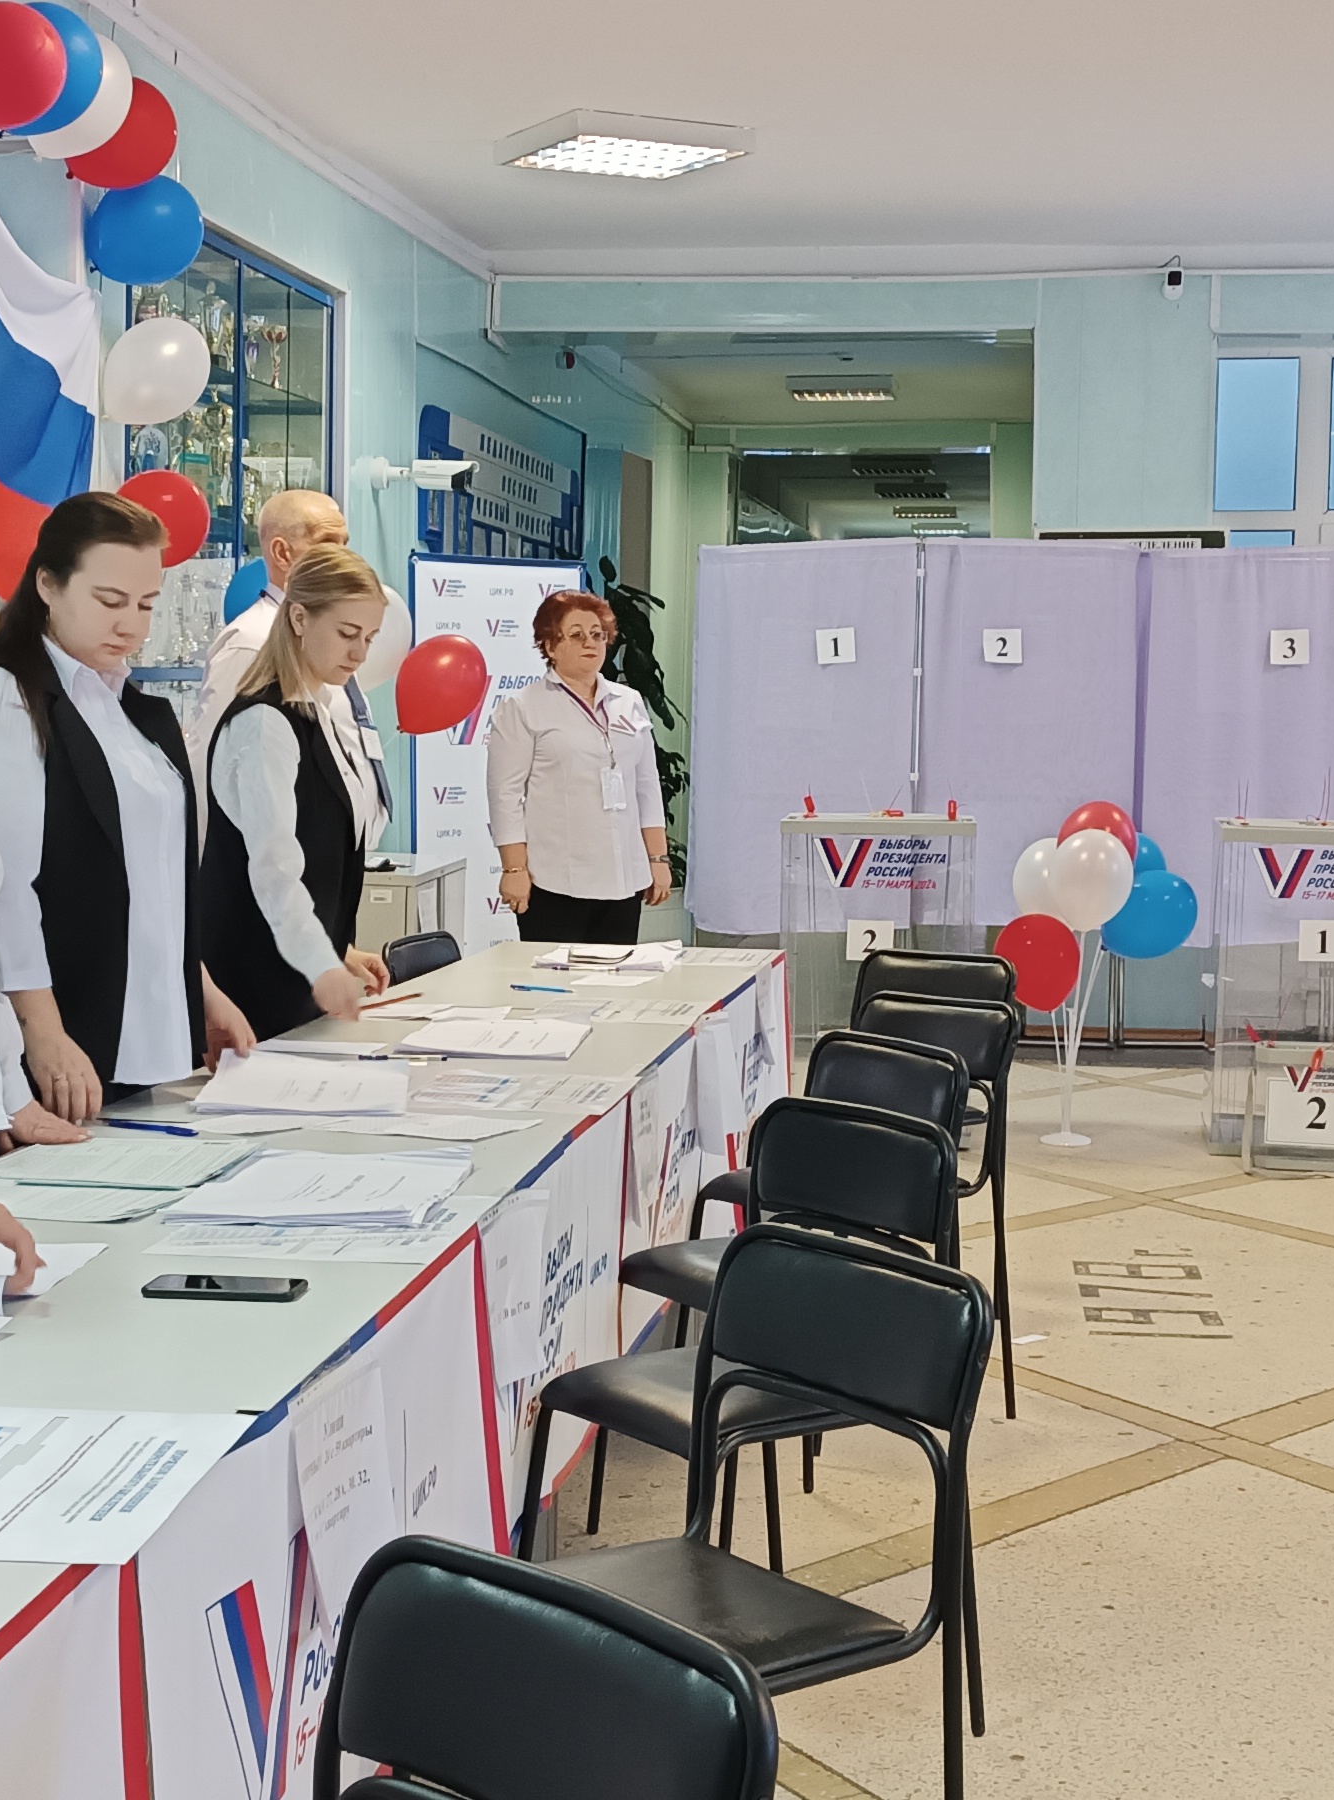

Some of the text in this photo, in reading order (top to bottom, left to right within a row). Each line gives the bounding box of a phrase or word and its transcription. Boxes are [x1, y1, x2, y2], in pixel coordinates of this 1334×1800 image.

[831, 637, 840, 657] 1
[995, 637, 1009, 657] 2
[1282, 637, 1296, 659] 3
[878, 838, 932, 850] ВЫБОРЫ
[872, 852, 947, 865] ПРЕЗИДЕНТА
[866, 866, 914, 877] РОССИИ
[885, 880, 914, 890] МАРТА
[915, 879, 937, 890] 2024
[862, 929, 877, 953] 2
[1317, 929, 1329, 954] 1
[1306, 1096, 1327, 1129] 2
